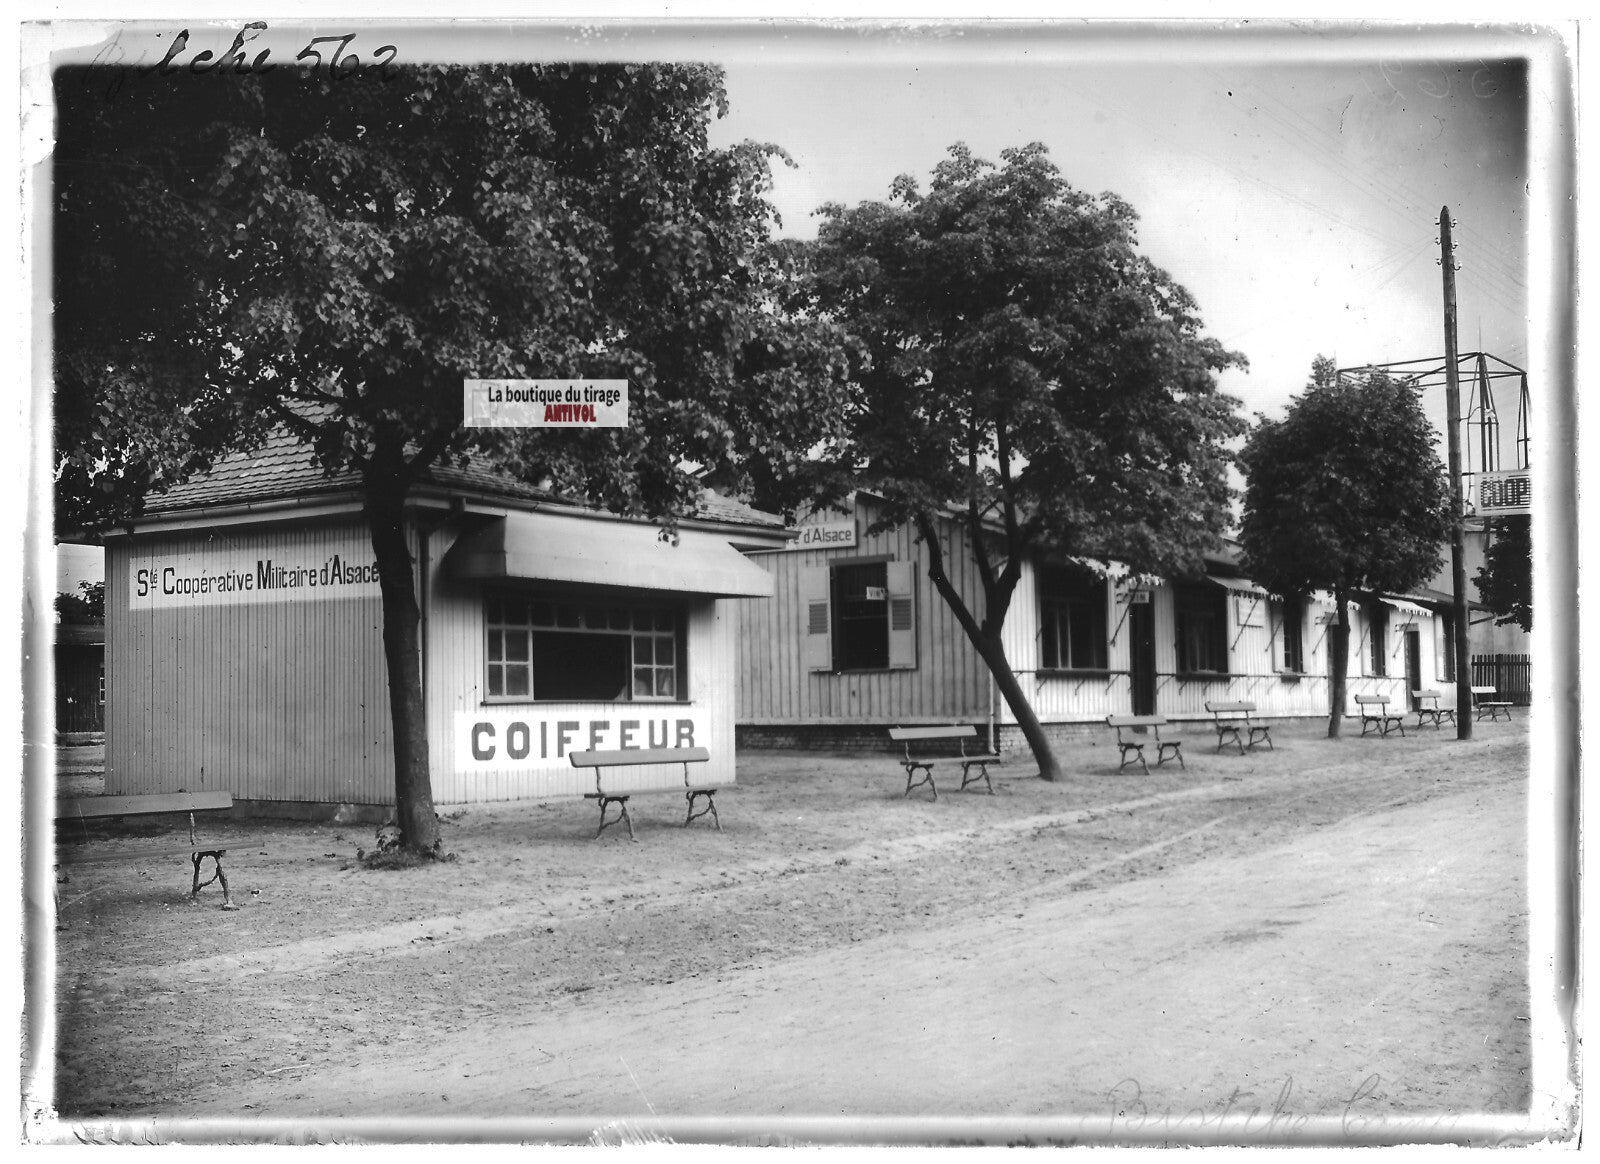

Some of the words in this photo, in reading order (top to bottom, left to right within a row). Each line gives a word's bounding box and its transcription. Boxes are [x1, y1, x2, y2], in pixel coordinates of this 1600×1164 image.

[297, 33, 398, 83] 562
[163, 567, 254, 598] Coopérative
[257, 560, 317, 590] Militaire
[320, 554, 380, 586] d'Alsace
[471, 719, 695, 761] COIFFEUR
